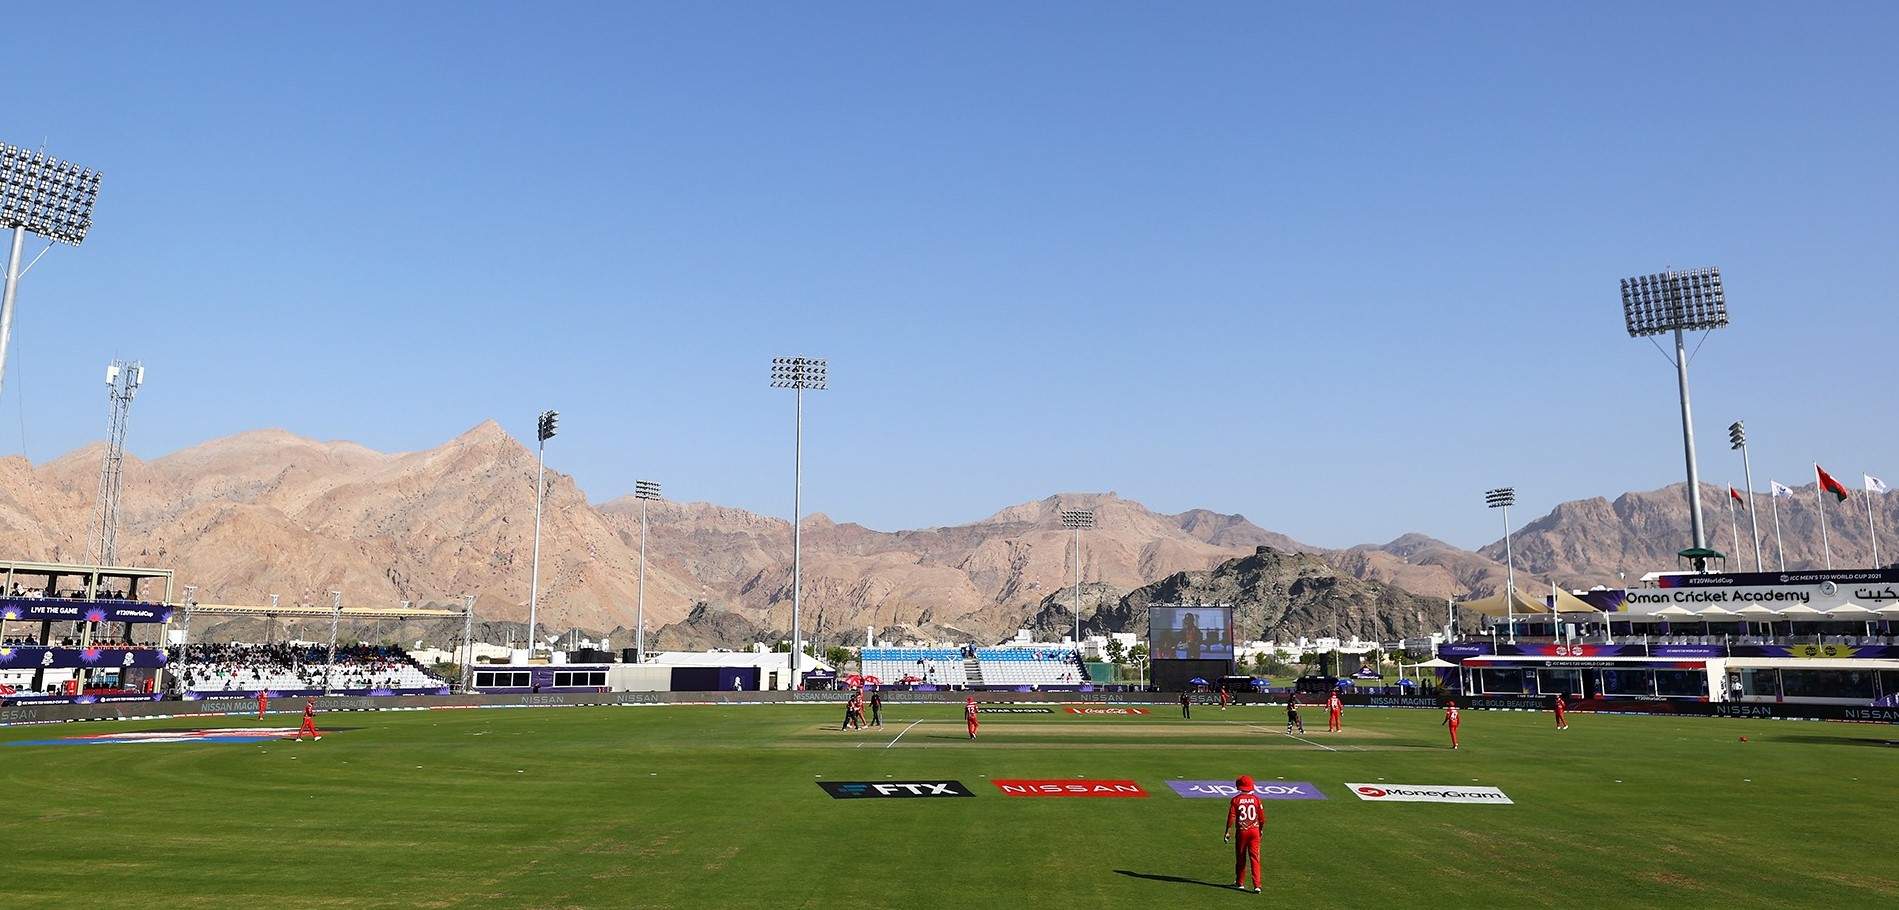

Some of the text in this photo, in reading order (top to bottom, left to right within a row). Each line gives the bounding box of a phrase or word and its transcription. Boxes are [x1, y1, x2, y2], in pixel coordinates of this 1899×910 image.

[1626, 589, 1810, 604] Oman Cricket Academy
[60, 607, 78, 615] GAME
[521, 696, 564, 704] NISSAN
[617, 694, 659, 702] NISSAN
[793, 692, 820, 700] NISSAN
[201, 700, 272, 712] NISSAN MAGNE
[1370, 697, 1437, 706] NISSAN MAGNITE
[966, 706, 976, 714] 12
[1717, 705, 1771, 715] NISSAN
[871, 783, 959, 795] FTX
[1001, 784, 1139, 793] NISSAN
[1197, 784, 1306, 796] uptox
[1385, 789, 1502, 799] MoneyGram
[1238, 804, 1257, 821] 30
